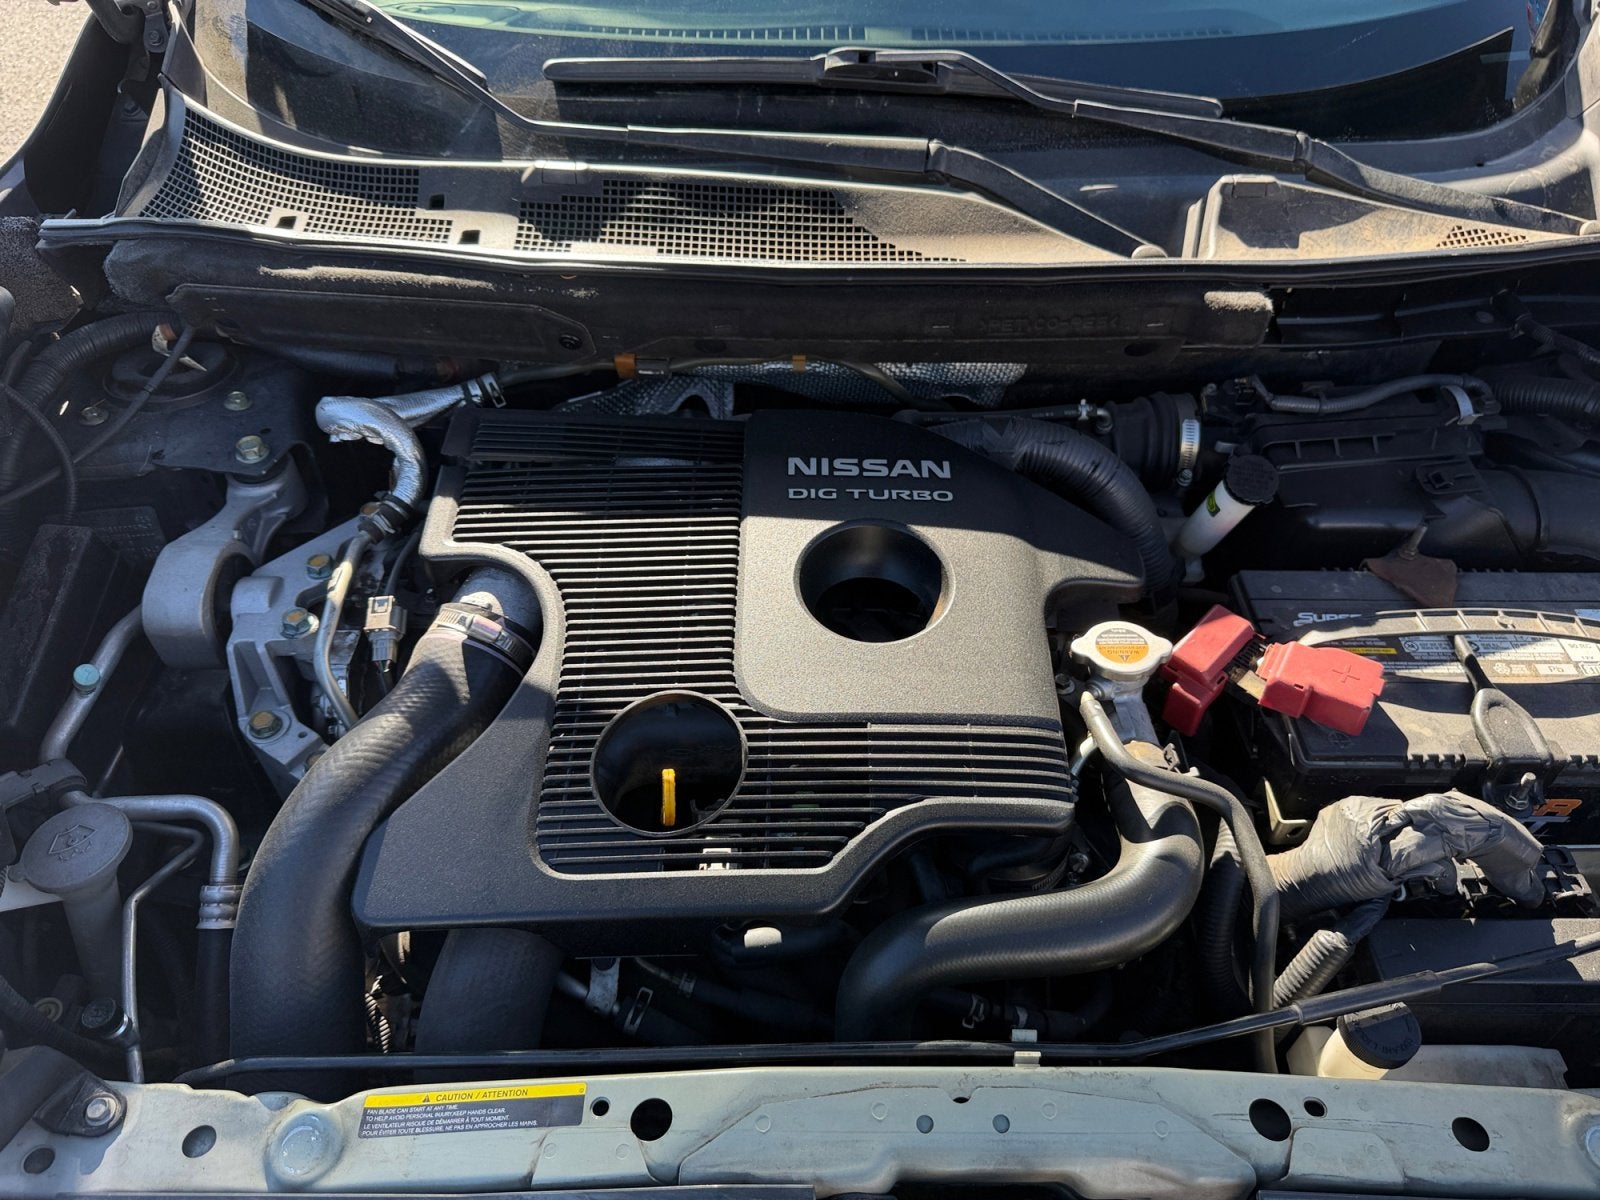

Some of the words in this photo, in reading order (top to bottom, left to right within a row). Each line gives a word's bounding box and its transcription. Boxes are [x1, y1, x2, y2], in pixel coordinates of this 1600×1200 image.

[788, 457, 951, 478] NISSAN
[788, 488, 837, 499] DIG
[846, 489, 953, 502] TURBO
[1547, 665, 1565, 673] Pb
[436, 1093, 473, 1102] CAUTION
[475, 1091, 481, 1099] /
[482, 1089, 529, 1099] ATTENTION
[435, 1116, 464, 1125] DÉMARRER
[473, 1121, 507, 1129] APPROCHER
